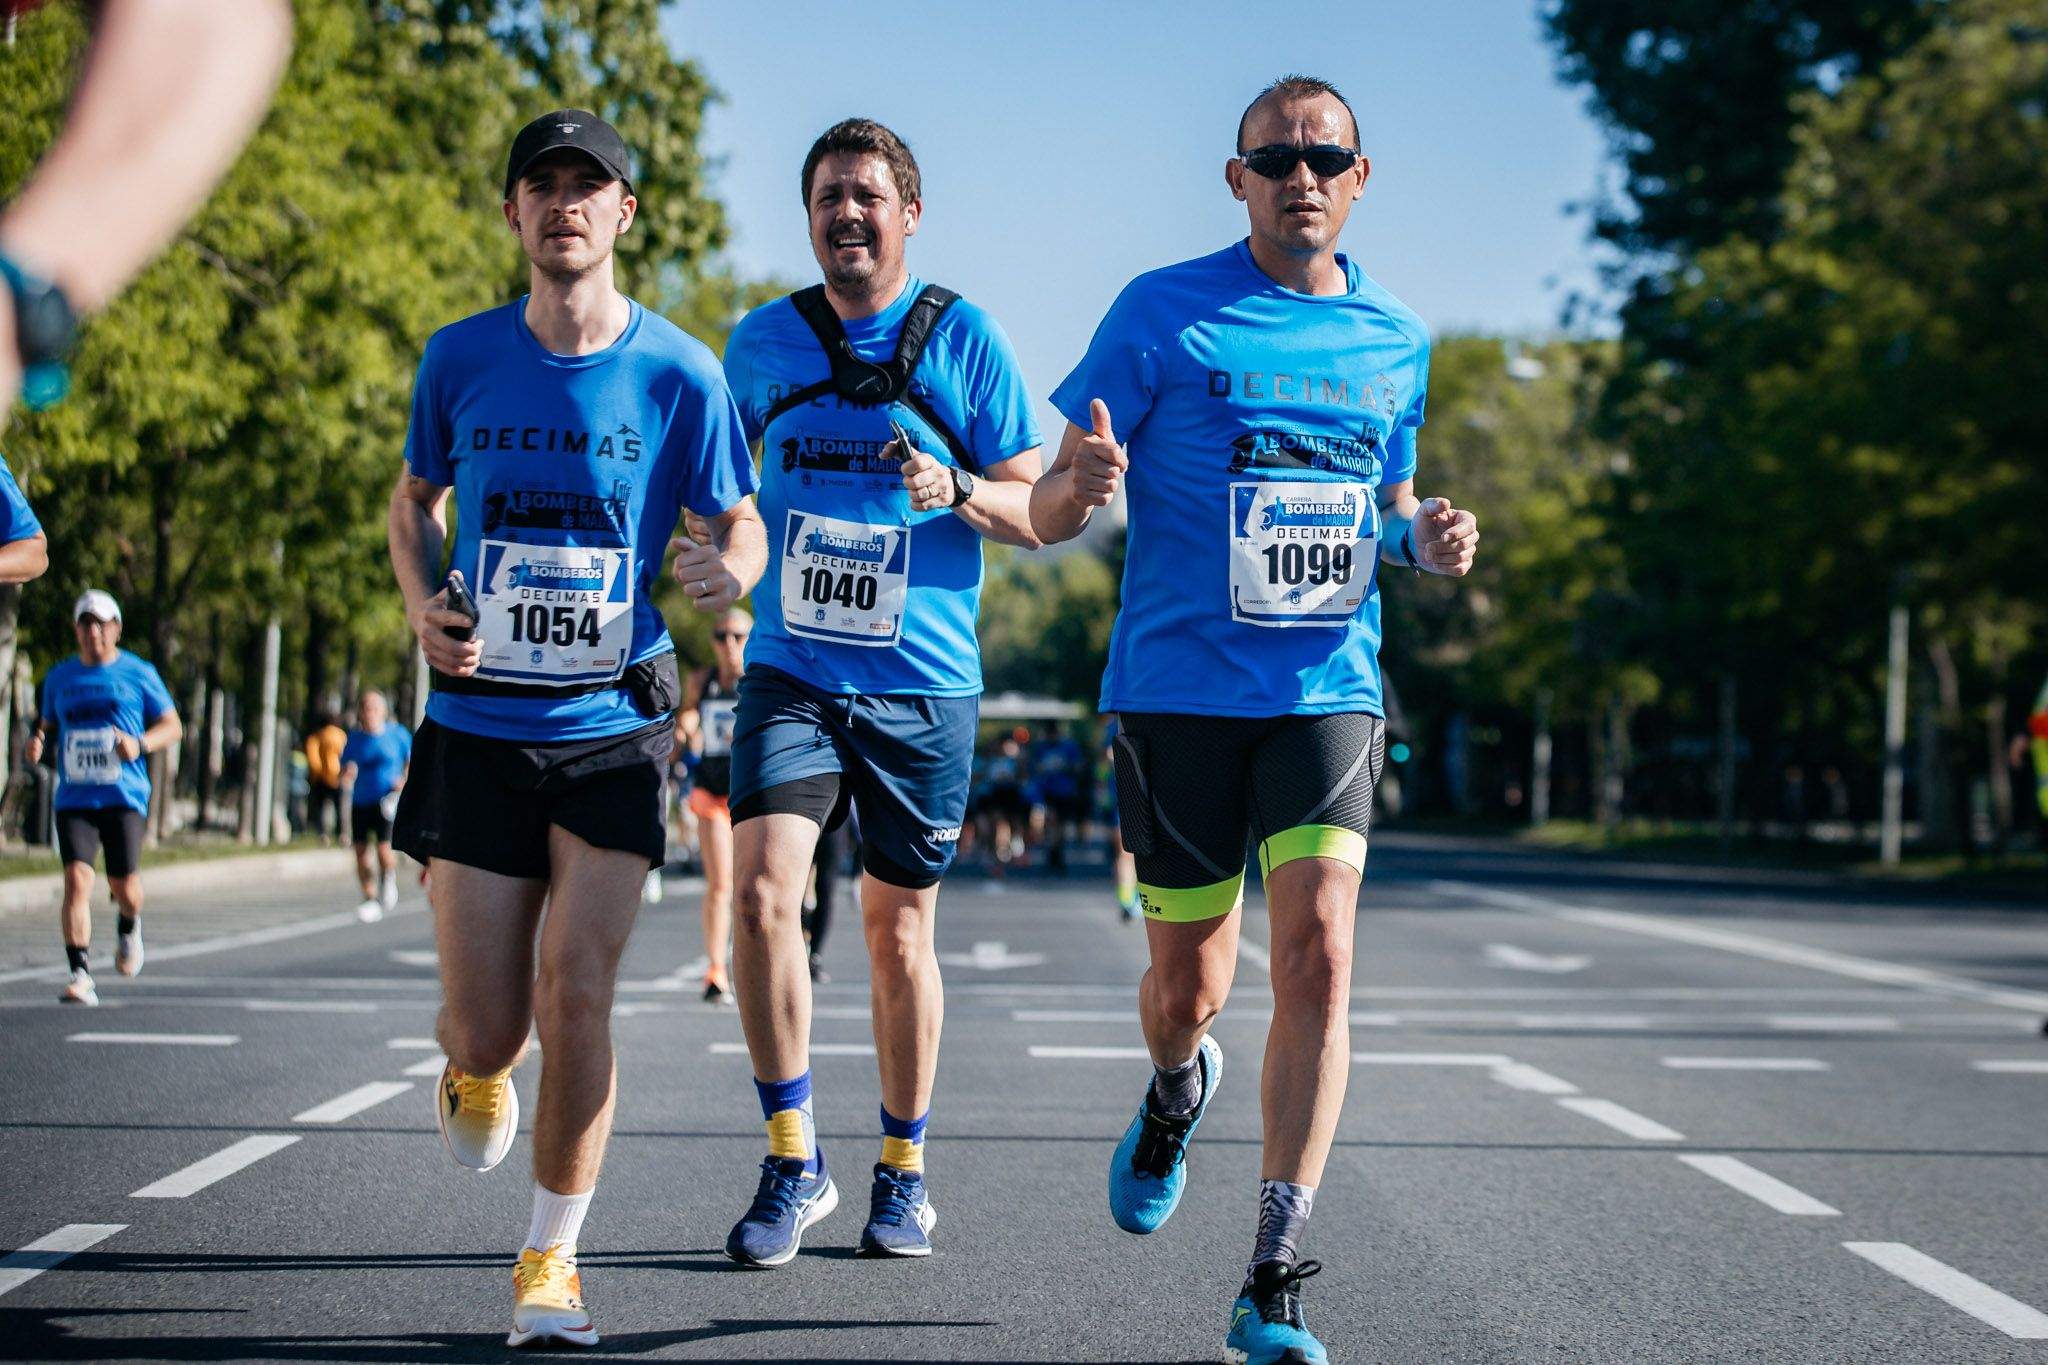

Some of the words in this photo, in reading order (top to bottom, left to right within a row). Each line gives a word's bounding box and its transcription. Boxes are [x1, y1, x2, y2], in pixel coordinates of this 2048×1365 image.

[1208, 370, 1396, 416] DECIMAS
[473, 428, 642, 463] DECIMAS
[811, 439, 887, 456] BOMBE
[1268, 432, 1377, 460] BOMBEROS
[849, 456, 864, 472] de
[866, 457, 901, 473] MADR
[1310, 452, 1328, 469] de
[1329, 453, 1372, 475] MADRID
[1285, 503, 1354, 515] BOMBEROS
[1277, 527, 1351, 539] DECIMAS
[820, 535, 883, 553] BOMBEROS
[530, 565, 603, 579] BOMBEROS
[811, 553, 879, 573] DECIMAS
[1261, 542, 1352, 586] 1099
[520, 588, 600, 603] DECIMAS
[800, 566, 878, 611] 1040
[507, 602, 602, 648] 1054
